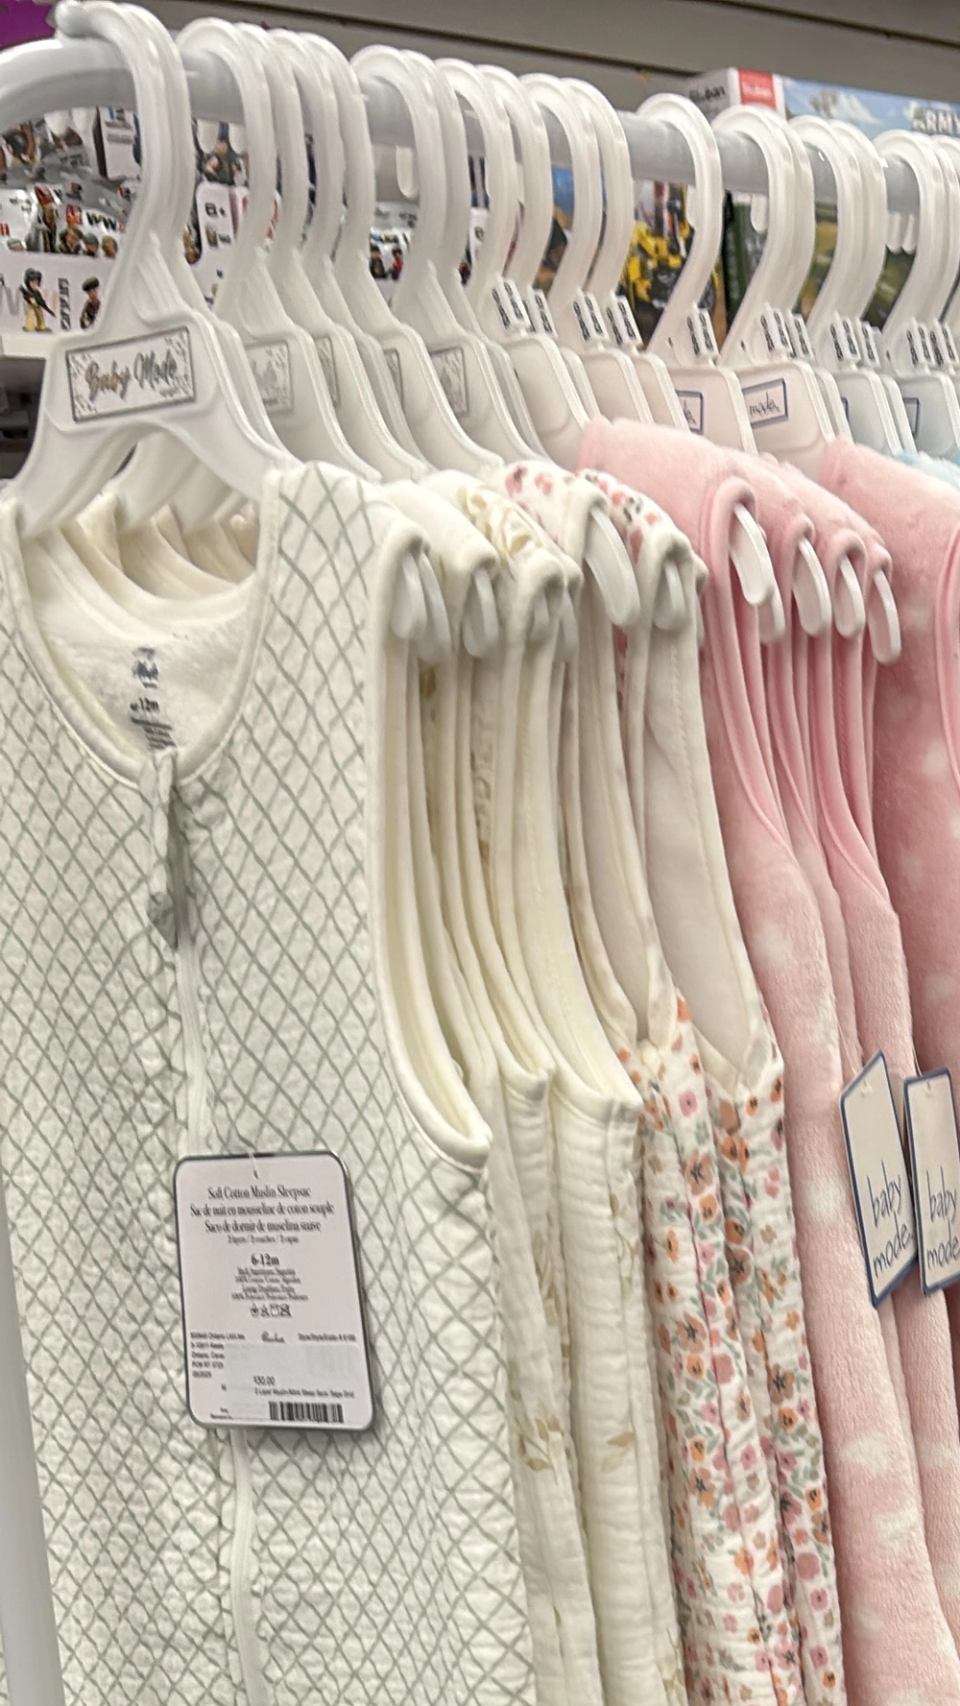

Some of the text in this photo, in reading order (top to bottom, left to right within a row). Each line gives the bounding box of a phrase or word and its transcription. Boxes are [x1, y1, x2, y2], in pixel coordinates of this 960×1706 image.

[224, 1186, 250, 1199] Cotton
[867, 1159, 902, 1228] baby
[926, 1165, 957, 1224] baby
